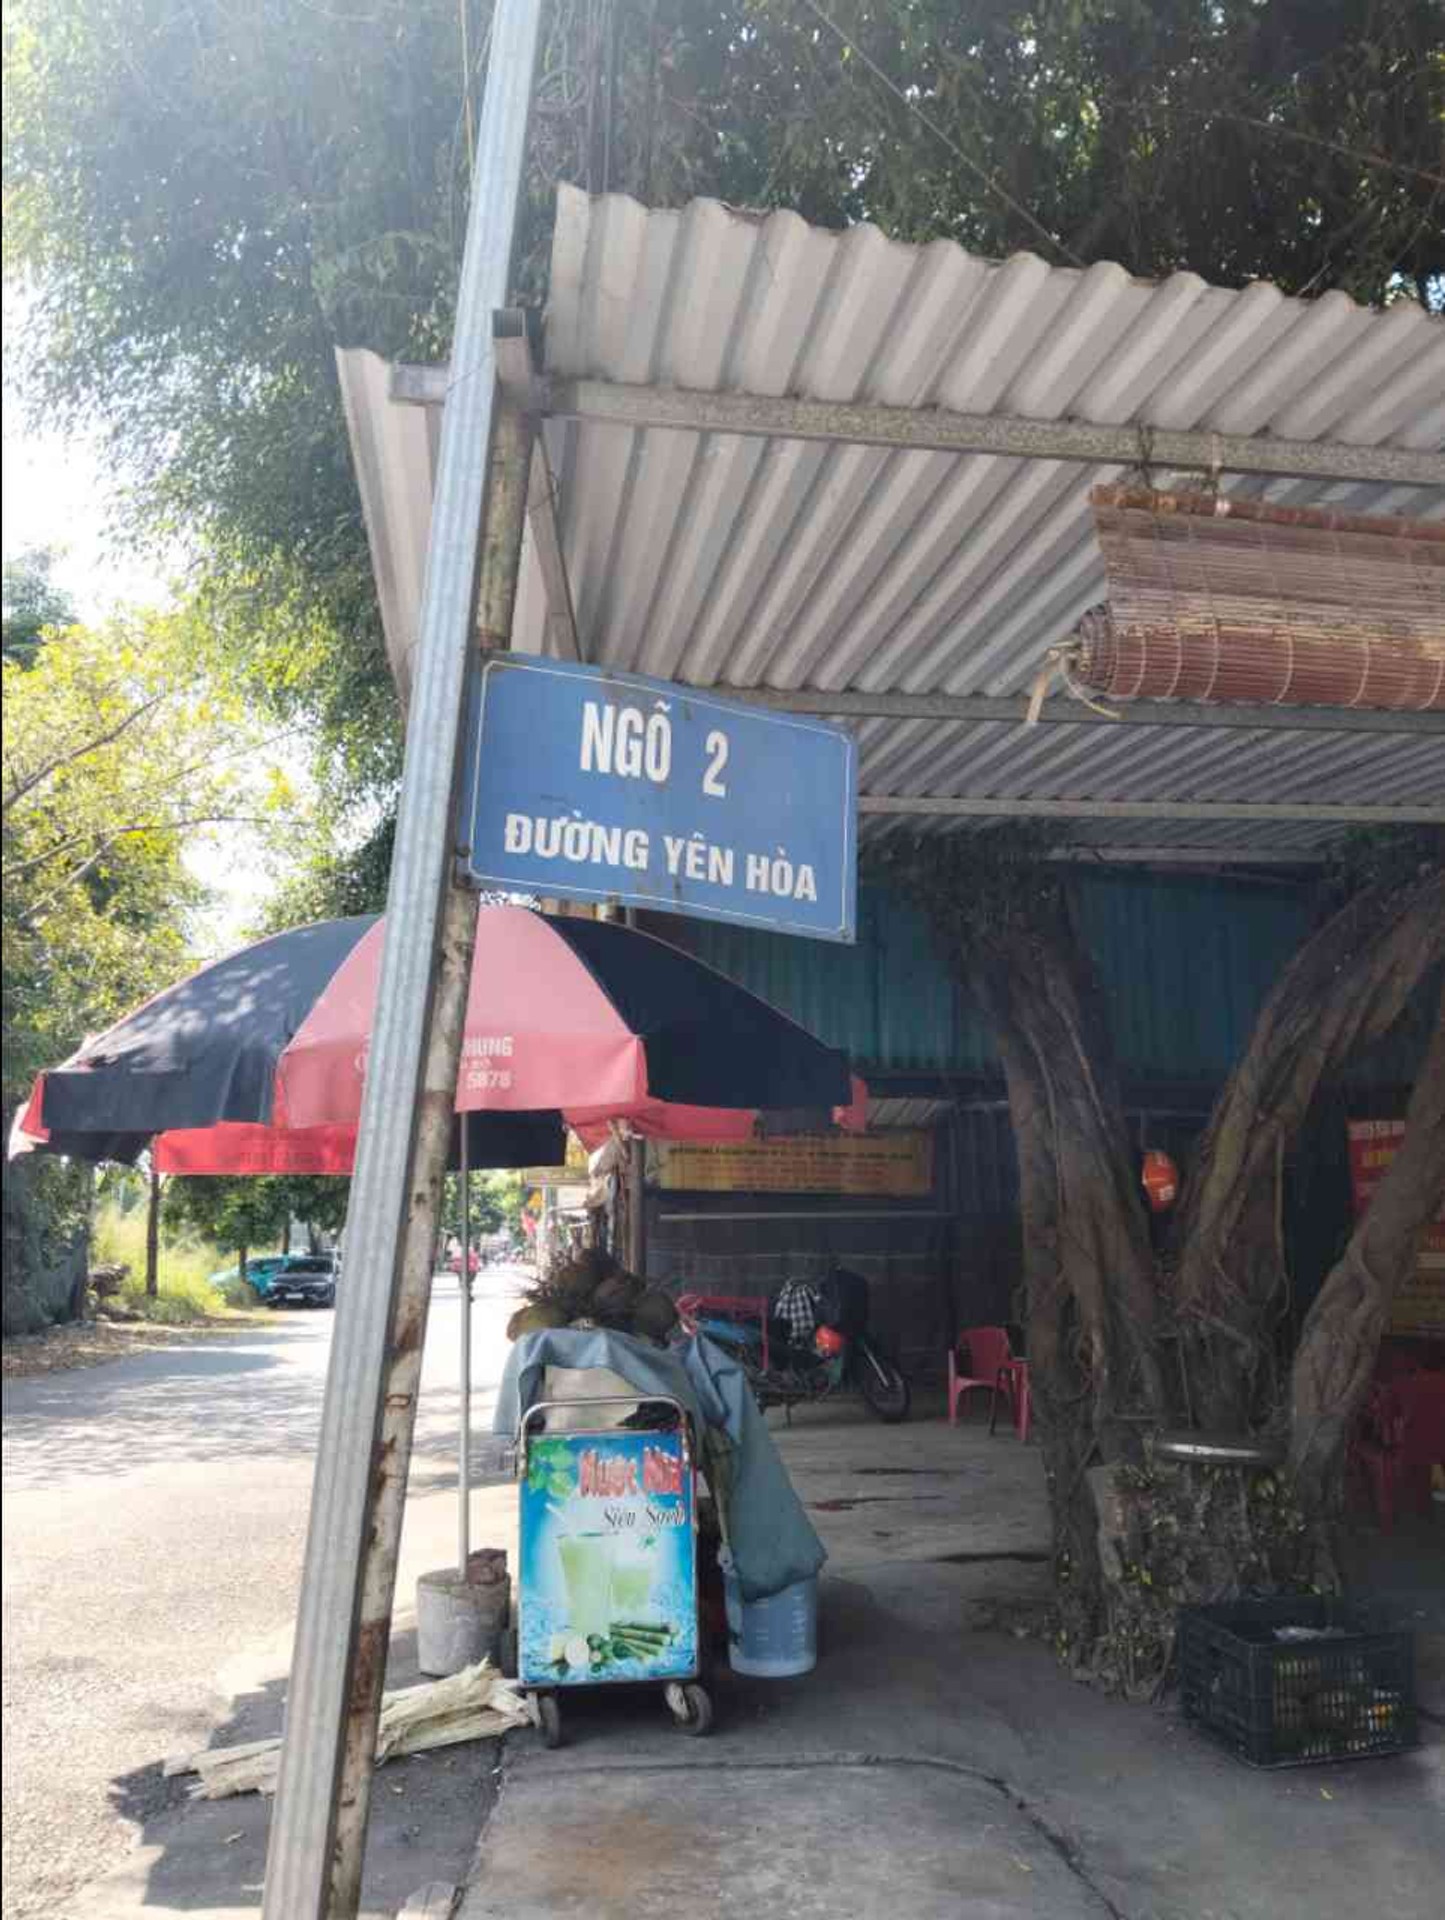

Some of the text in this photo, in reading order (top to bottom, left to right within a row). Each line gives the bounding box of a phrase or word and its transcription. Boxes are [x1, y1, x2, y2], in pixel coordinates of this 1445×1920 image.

[580, 700, 730, 798] NGÕ 2
[504, 809, 818, 903] ĐƯỜNG YÊN HÒA
